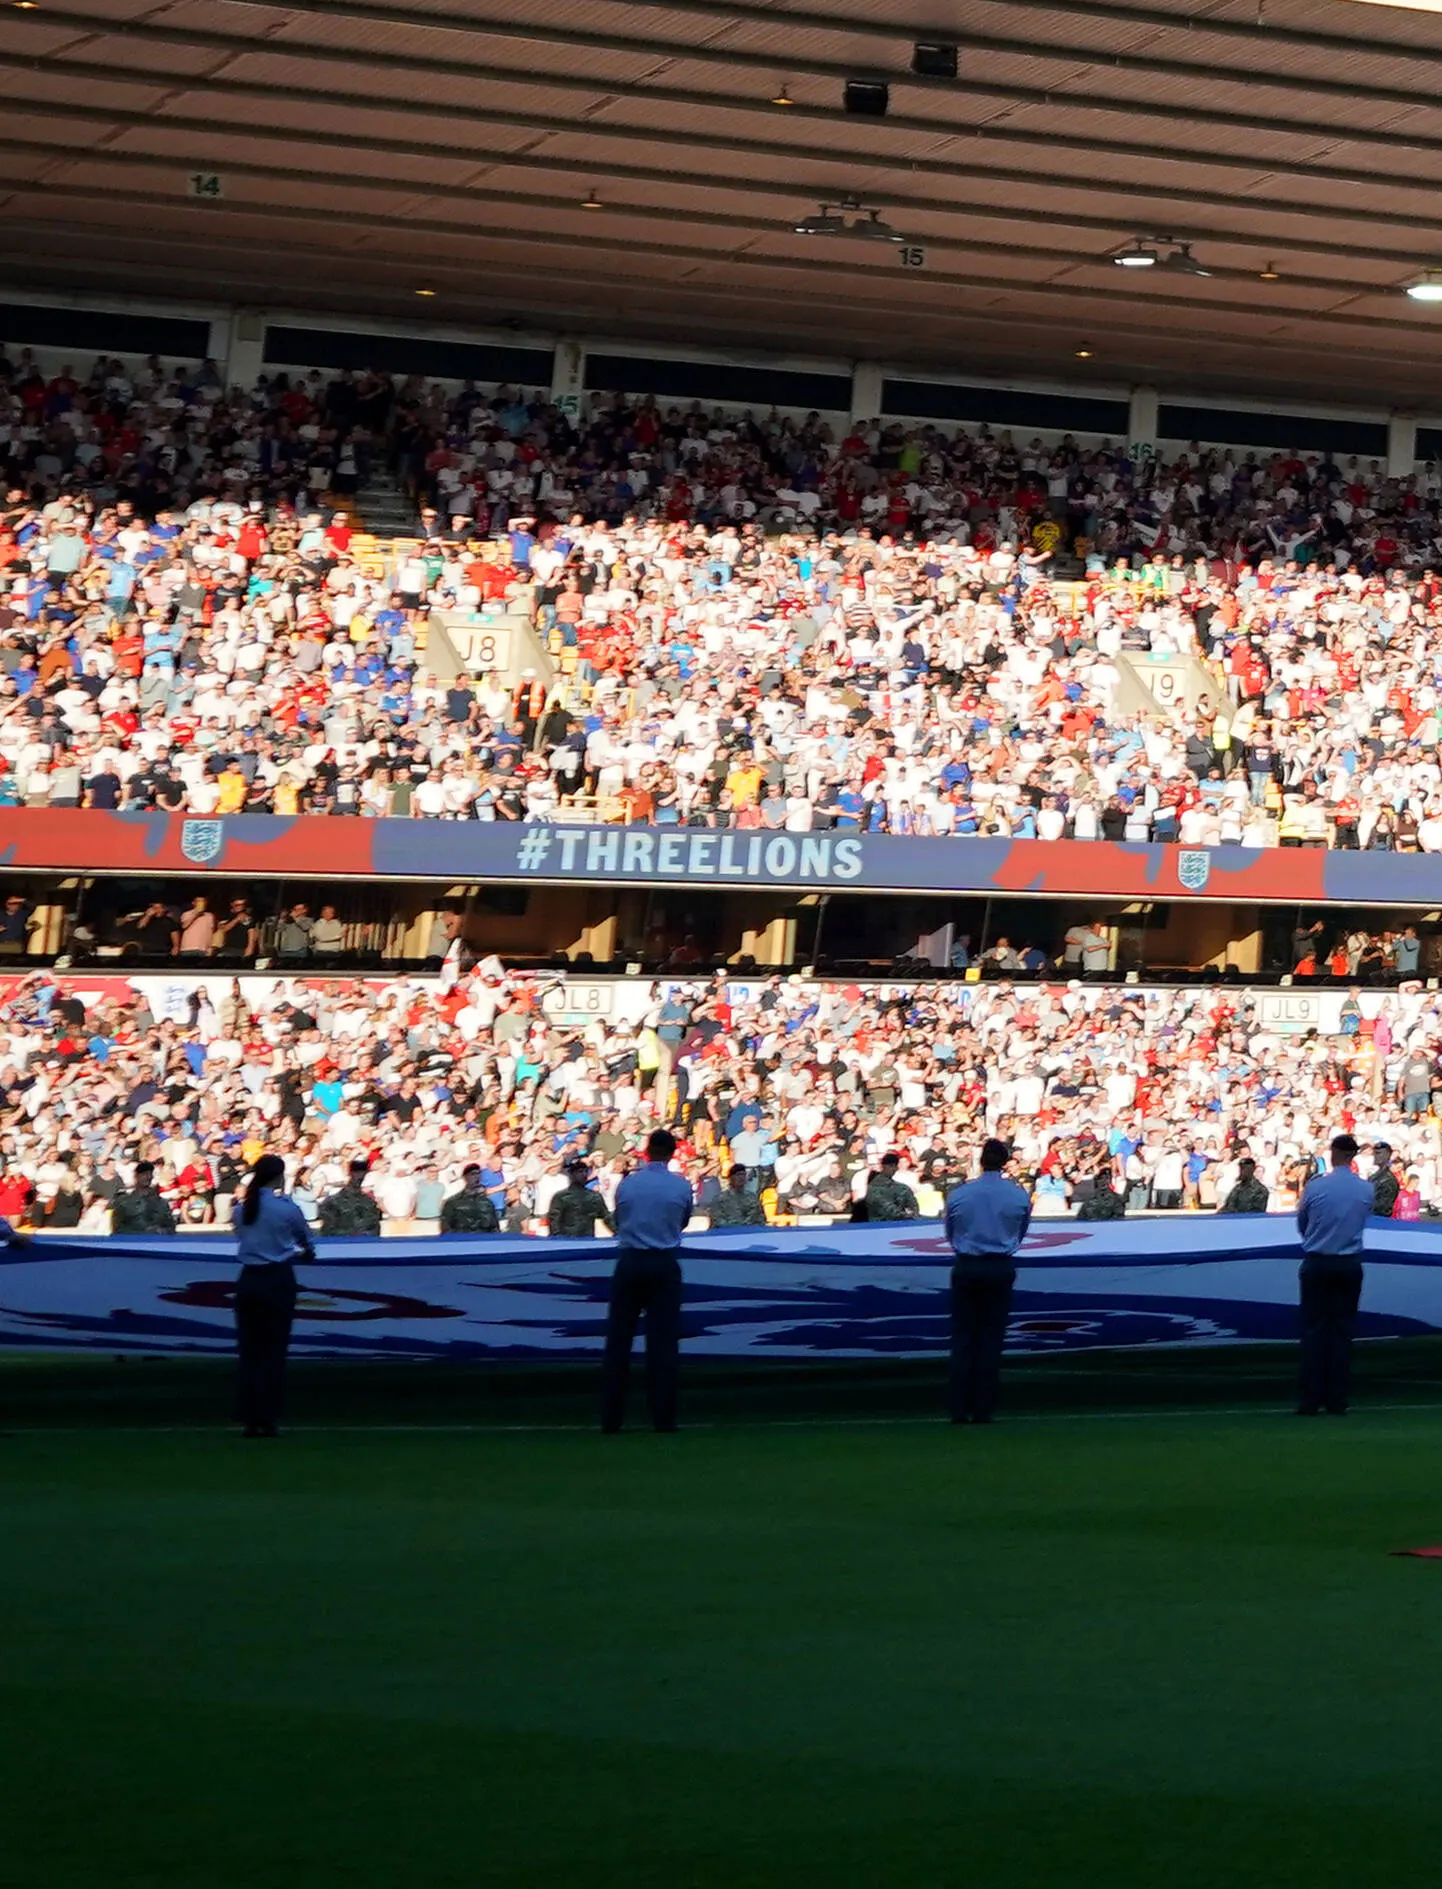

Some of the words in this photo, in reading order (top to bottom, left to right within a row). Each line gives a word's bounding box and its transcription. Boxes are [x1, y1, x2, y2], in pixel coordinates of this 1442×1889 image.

[191, 175, 219, 195] 14
[898, 247, 924, 266] 15
[460, 636, 497, 662] J8
[516, 828, 864, 880] #THREELIONS
